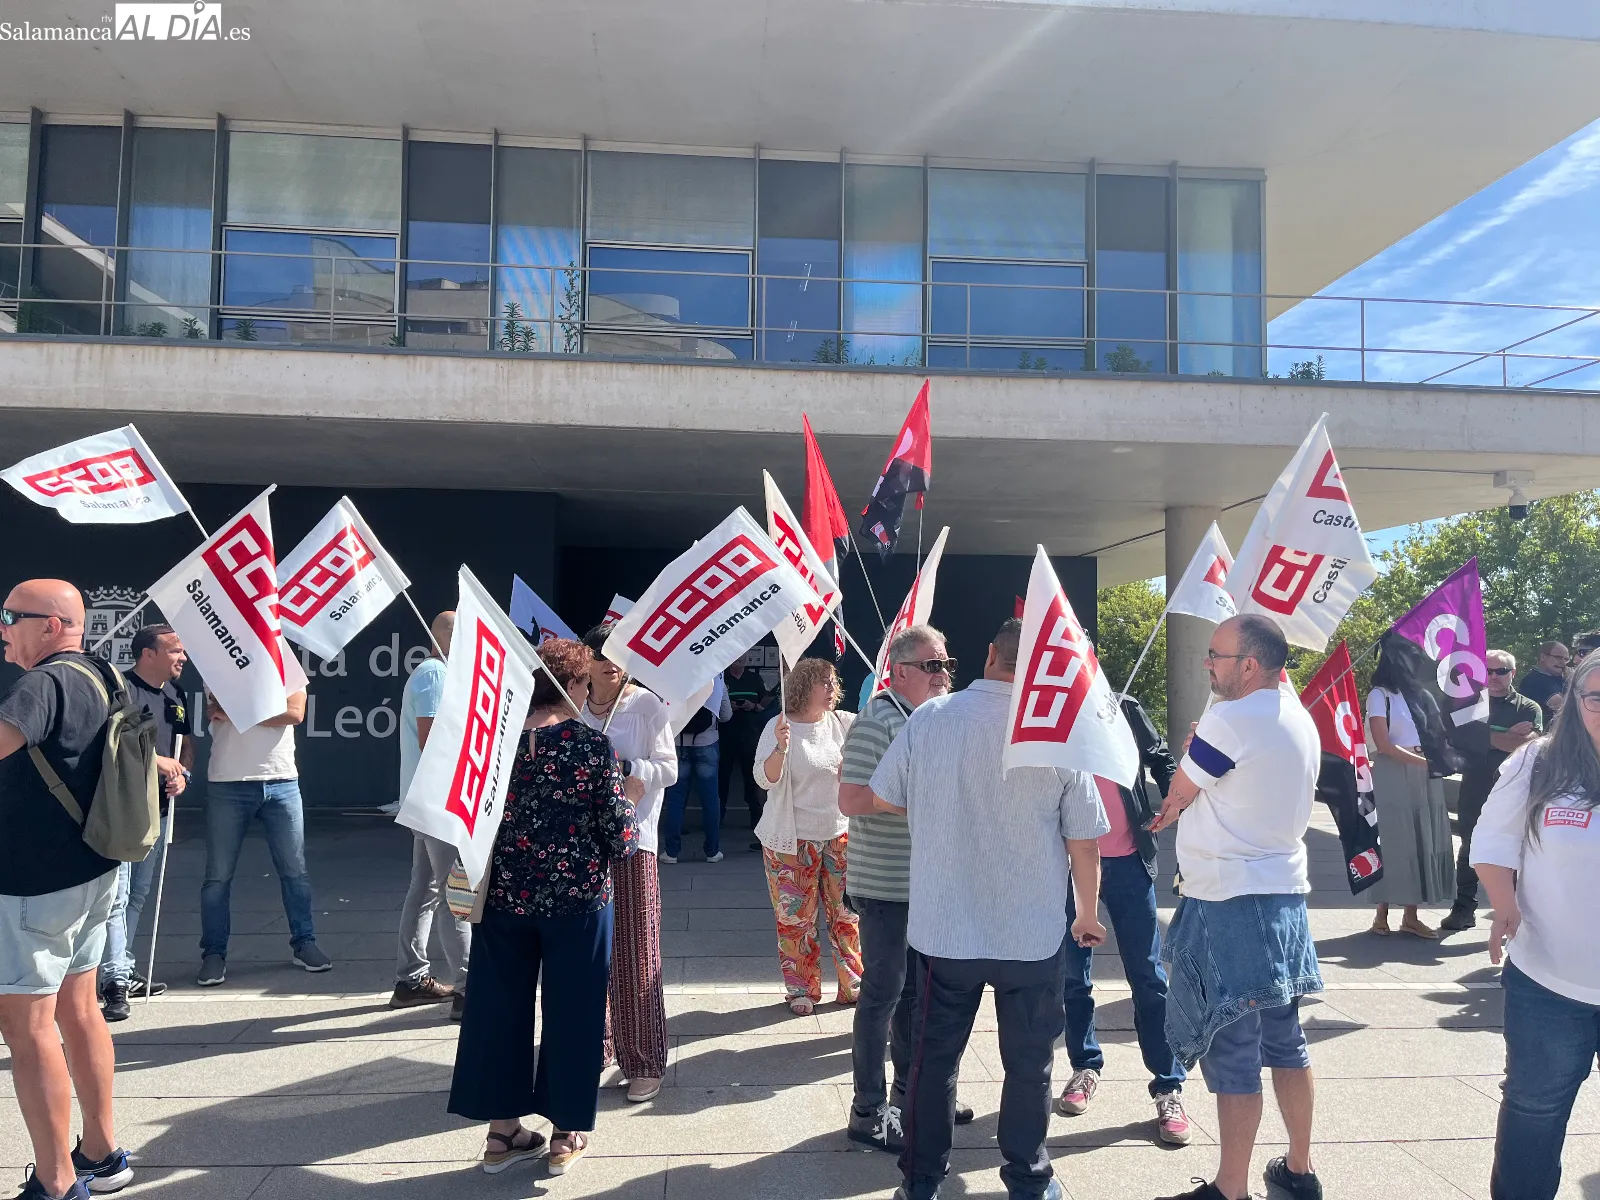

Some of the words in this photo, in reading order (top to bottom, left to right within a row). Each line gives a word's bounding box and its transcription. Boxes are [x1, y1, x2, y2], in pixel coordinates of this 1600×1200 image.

[186, 578, 251, 670] Salamanca
[640, 543, 764, 653] CCOO
[688, 582, 782, 656] Salamanca
[306, 695, 398, 738] Leó
[1424, 613, 1490, 728] CGT
[457, 634, 501, 818] CCOO
[484, 687, 515, 817] Salamanca
[1550, 810, 1585, 819] CCOO
